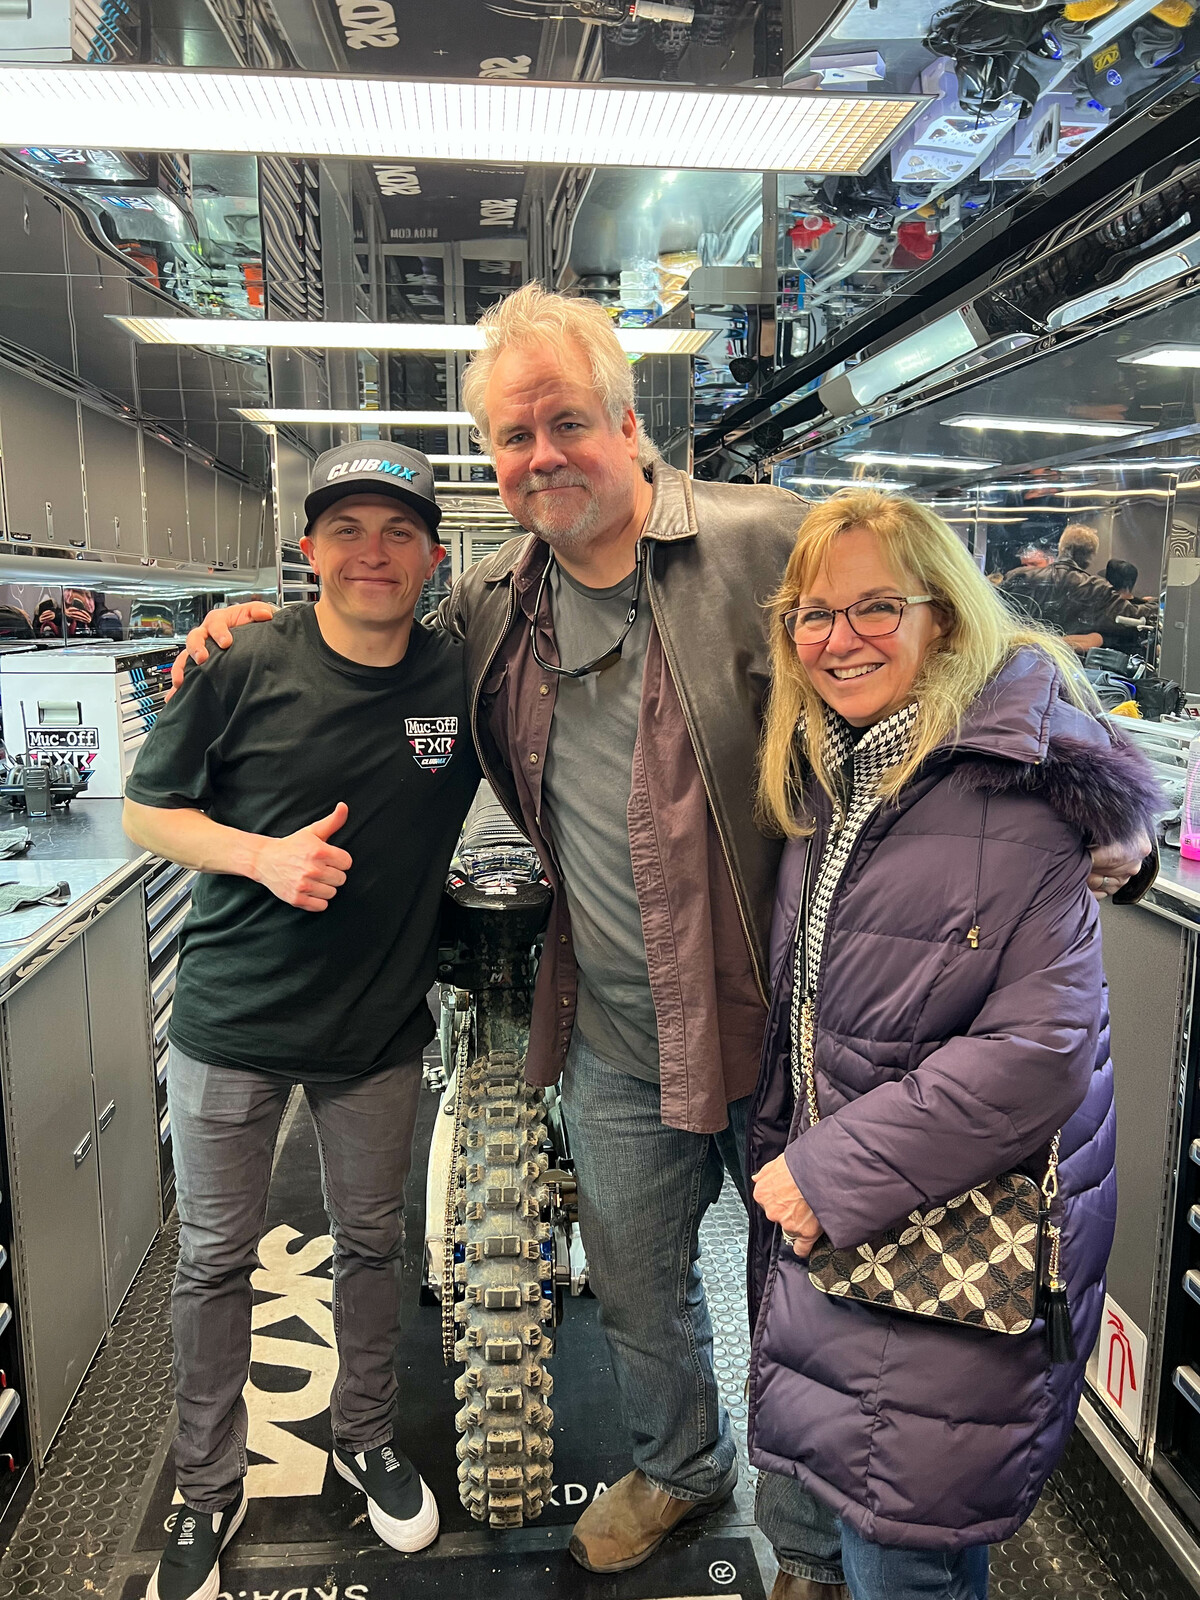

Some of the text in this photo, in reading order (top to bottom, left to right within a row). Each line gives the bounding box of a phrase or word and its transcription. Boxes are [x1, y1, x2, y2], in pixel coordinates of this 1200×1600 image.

[326, 459, 418, 482] CLUBMX
[408, 719, 456, 734] Muc-Off
[29, 731, 95, 747] Muc-Off
[414, 737, 452, 754] FXR
